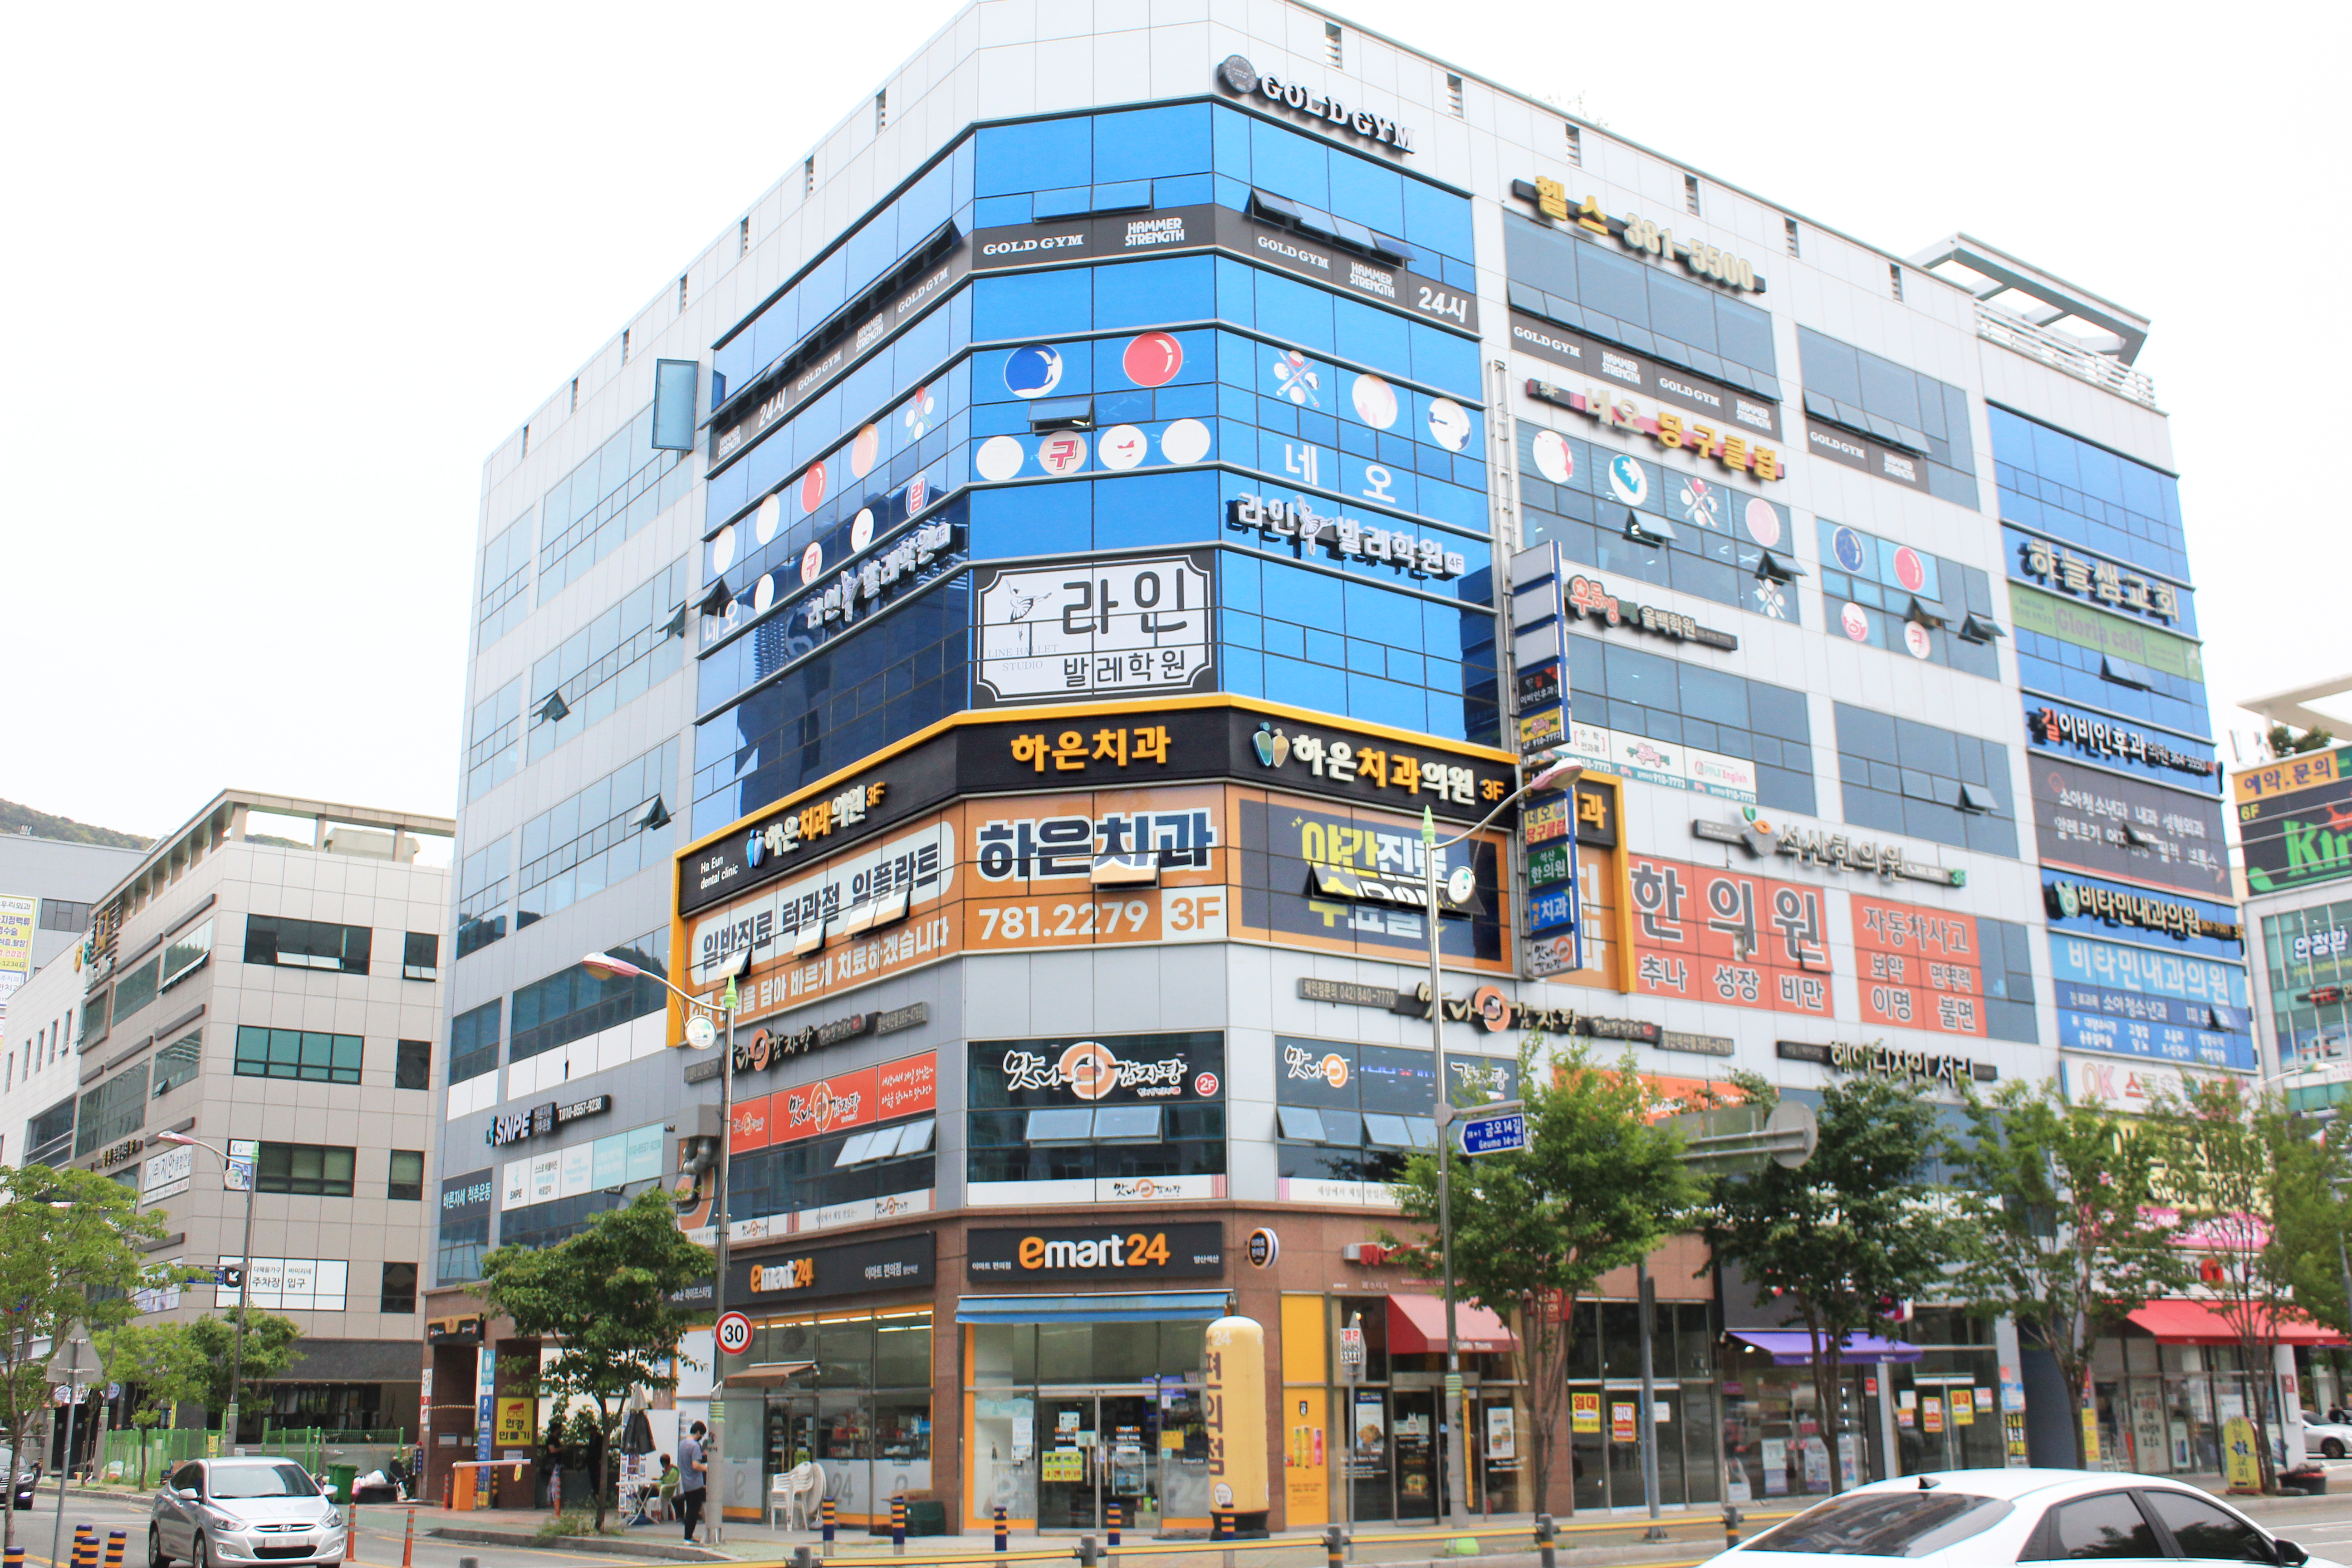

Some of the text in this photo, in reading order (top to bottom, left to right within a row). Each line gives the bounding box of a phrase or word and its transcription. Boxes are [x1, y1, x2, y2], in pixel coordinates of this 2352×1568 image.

[1125, 229, 1185, 247] STRENGTH
[1127, 217, 1182, 234] HAMMER
[1535, 175, 1754, 292] 헬스 381-5500
[983, 234, 1084, 255] GOLD GYM
[1258, 235, 1329, 270] GOLD GYM
[898, 267, 949, 313] GOLD GYM
[1350, 273, 1395, 299] STRENGTH
[1351, 261, 1393, 286] HAMMER
[1419, 287, 1468, 323] 24시
[857, 313, 883, 342] HAMMER
[1514, 325, 1581, 358] GOLD GYM
[798, 351, 842, 391] GOLD GYM
[1602, 351, 1638, 373] HAMMER
[1602, 362, 1641, 385] STRENGTH
[759, 387, 787, 429] 24시
[1659, 377, 1720, 407] GOLD GYM
[1585, 388, 1645, 434] 네오
[1237, 491, 1462, 575] 라인 발레학원 4F
[2027, 538, 2180, 623] 하늘샘교회
[1062, 568, 1188, 636] 라인
[1570, 576, 1696, 641] 우등생 올백학원
[988, 643, 1059, 659] LINE BALLET
[1002, 660, 1044, 671] STUDIO
[1063, 649, 1186, 688] 발레학원
[1010, 725, 1171, 772] 하은치과
[1291, 734, 1476, 806] 하은치과의원
[1479, 779, 1504, 801] 3F
[765, 781, 886, 857] 하은치과의원 3F
[1528, 805, 1552, 825] 네오
[2240, 804, 2260, 821] 6F
[976, 807, 1218, 882] 하은치과
[1301, 820, 1448, 888] 야간진료
[1777, 822, 1905, 882] 석산한의원
[701, 855, 723, 874] Ha Eun
[701, 863, 738, 889] dental clinic
[852, 843, 939, 906] 임플란트
[1530, 858, 1566, 885] 한의원
[0, 915, 31, 926] 지정맥류
[978, 895, 1221, 941] 781.2279 3F
[1541, 896, 1568, 922] 치과
[1631, 861, 1825, 965] 한의원
[2078, 884, 2202, 939] 비타민내과의원
[1865, 906, 1970, 955] 자동차사고
[760, 916, 950, 1008] 담아 바르게 치료하겠습니다
[1870, 952, 1972, 992] 보약 면역력
[2068, 940, 2230, 1005] 비타민내과의원
[1640, 953, 1824, 1010] 추나 성장 비만
[1873, 985, 1975, 1031] 이명 불면
[1003, 1049, 1188, 1092] 맛나 감자탕
[1284, 1044, 1325, 1080] 맛나
[1198, 1076, 1215, 1091] 2F
[496, 1112, 532, 1145] SNPE
[788, 1094, 813, 1128] 맛나
[443, 1181, 491, 1209] 바른자세 척추운동
[510, 1187, 523, 1200] SNPE
[972, 1259, 1012, 1270] 이마트 편의점
[1018, 1232, 1171, 1270] emart24
[252, 1276, 306, 1288] 주차장 입구
[750, 1257, 814, 1294] emart24
[864, 1260, 902, 1280] 이마트 편의점
[725, 1324, 744, 1343] 30
[1574, 1396, 1597, 1410] 임대
[1613, 1405, 1633, 1421] 임대
[505, 1418, 524, 1430] 안경
